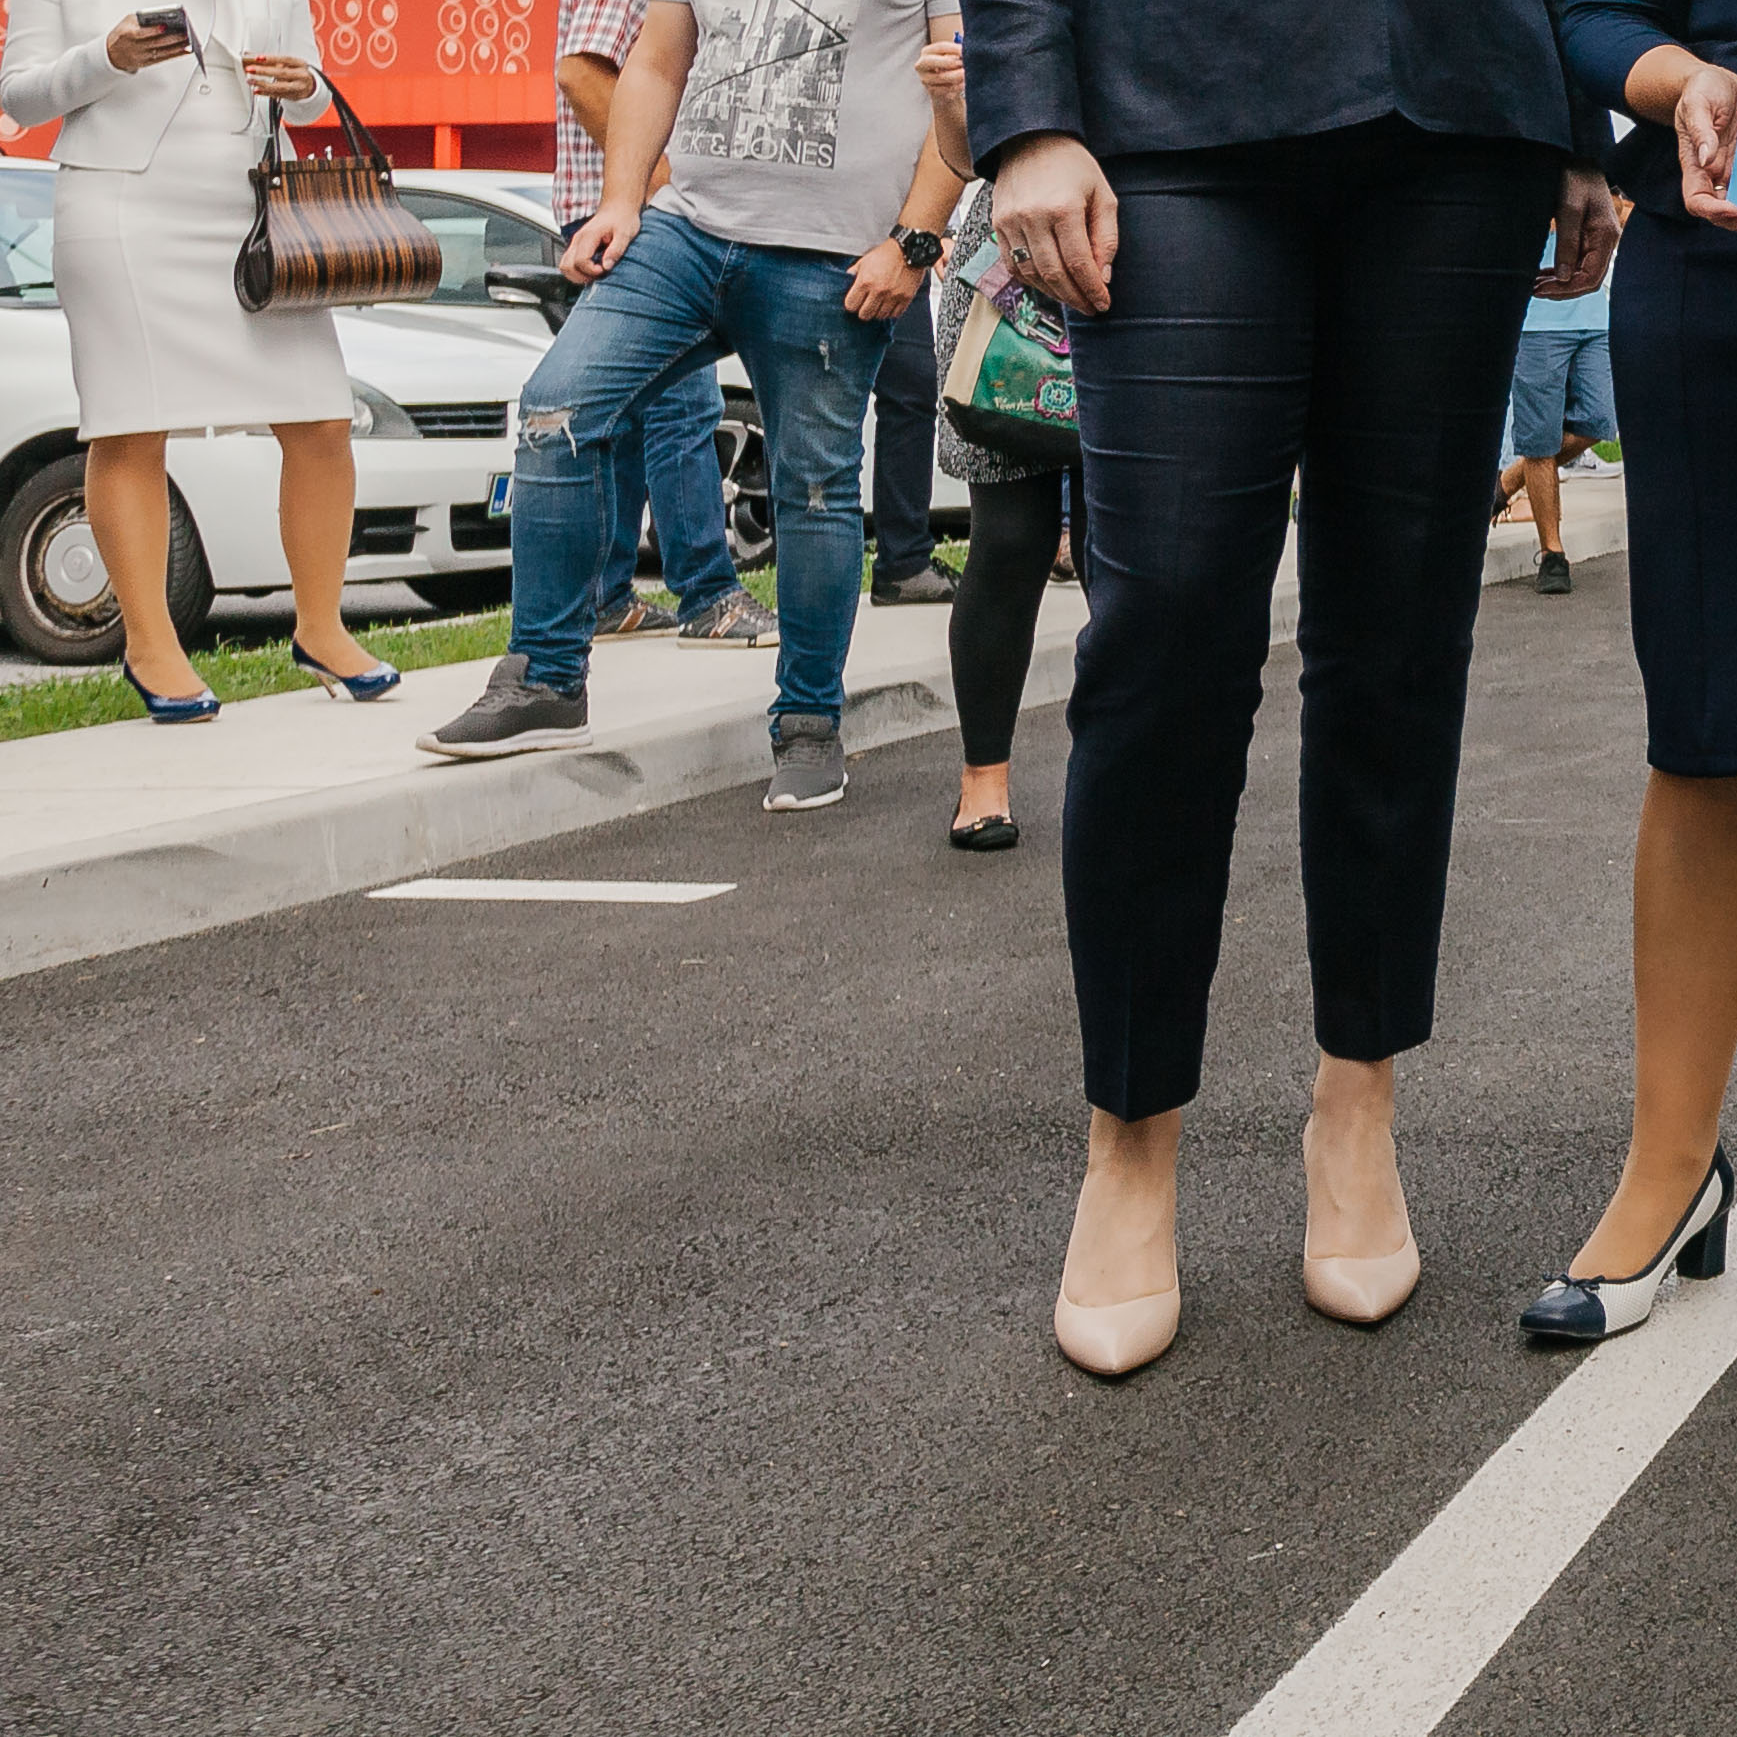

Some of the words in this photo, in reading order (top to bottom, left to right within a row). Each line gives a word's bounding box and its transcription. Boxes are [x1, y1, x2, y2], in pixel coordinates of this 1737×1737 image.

[679, 130, 700, 154] CK
[710, 133, 728, 158] &
[734, 136, 834, 168] JONES
